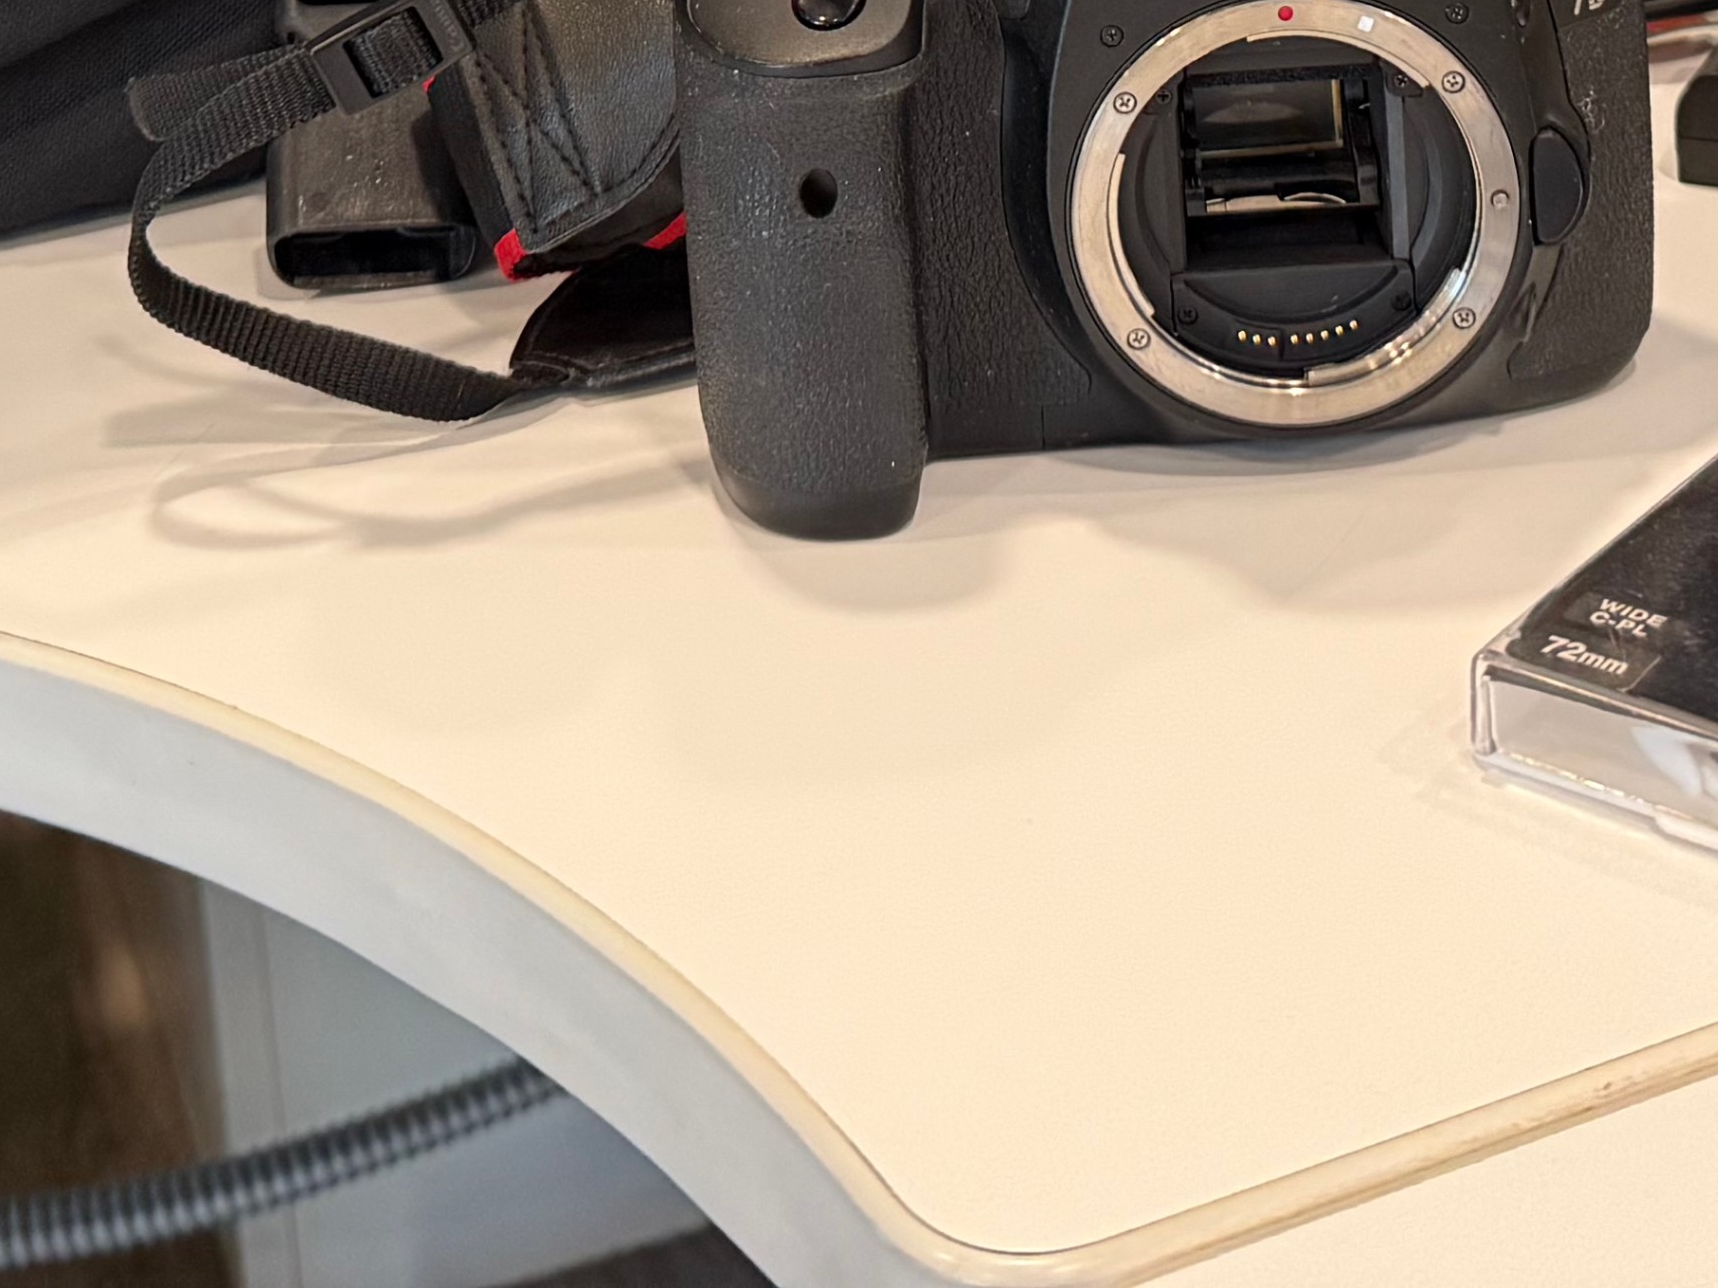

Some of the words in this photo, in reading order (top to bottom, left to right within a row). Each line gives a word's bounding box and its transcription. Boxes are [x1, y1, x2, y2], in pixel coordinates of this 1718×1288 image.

[1590, 611, 1648, 638] C-PL
[1600, 598, 1668, 628] WIDE
[1540, 635, 1629, 675] 72mm
